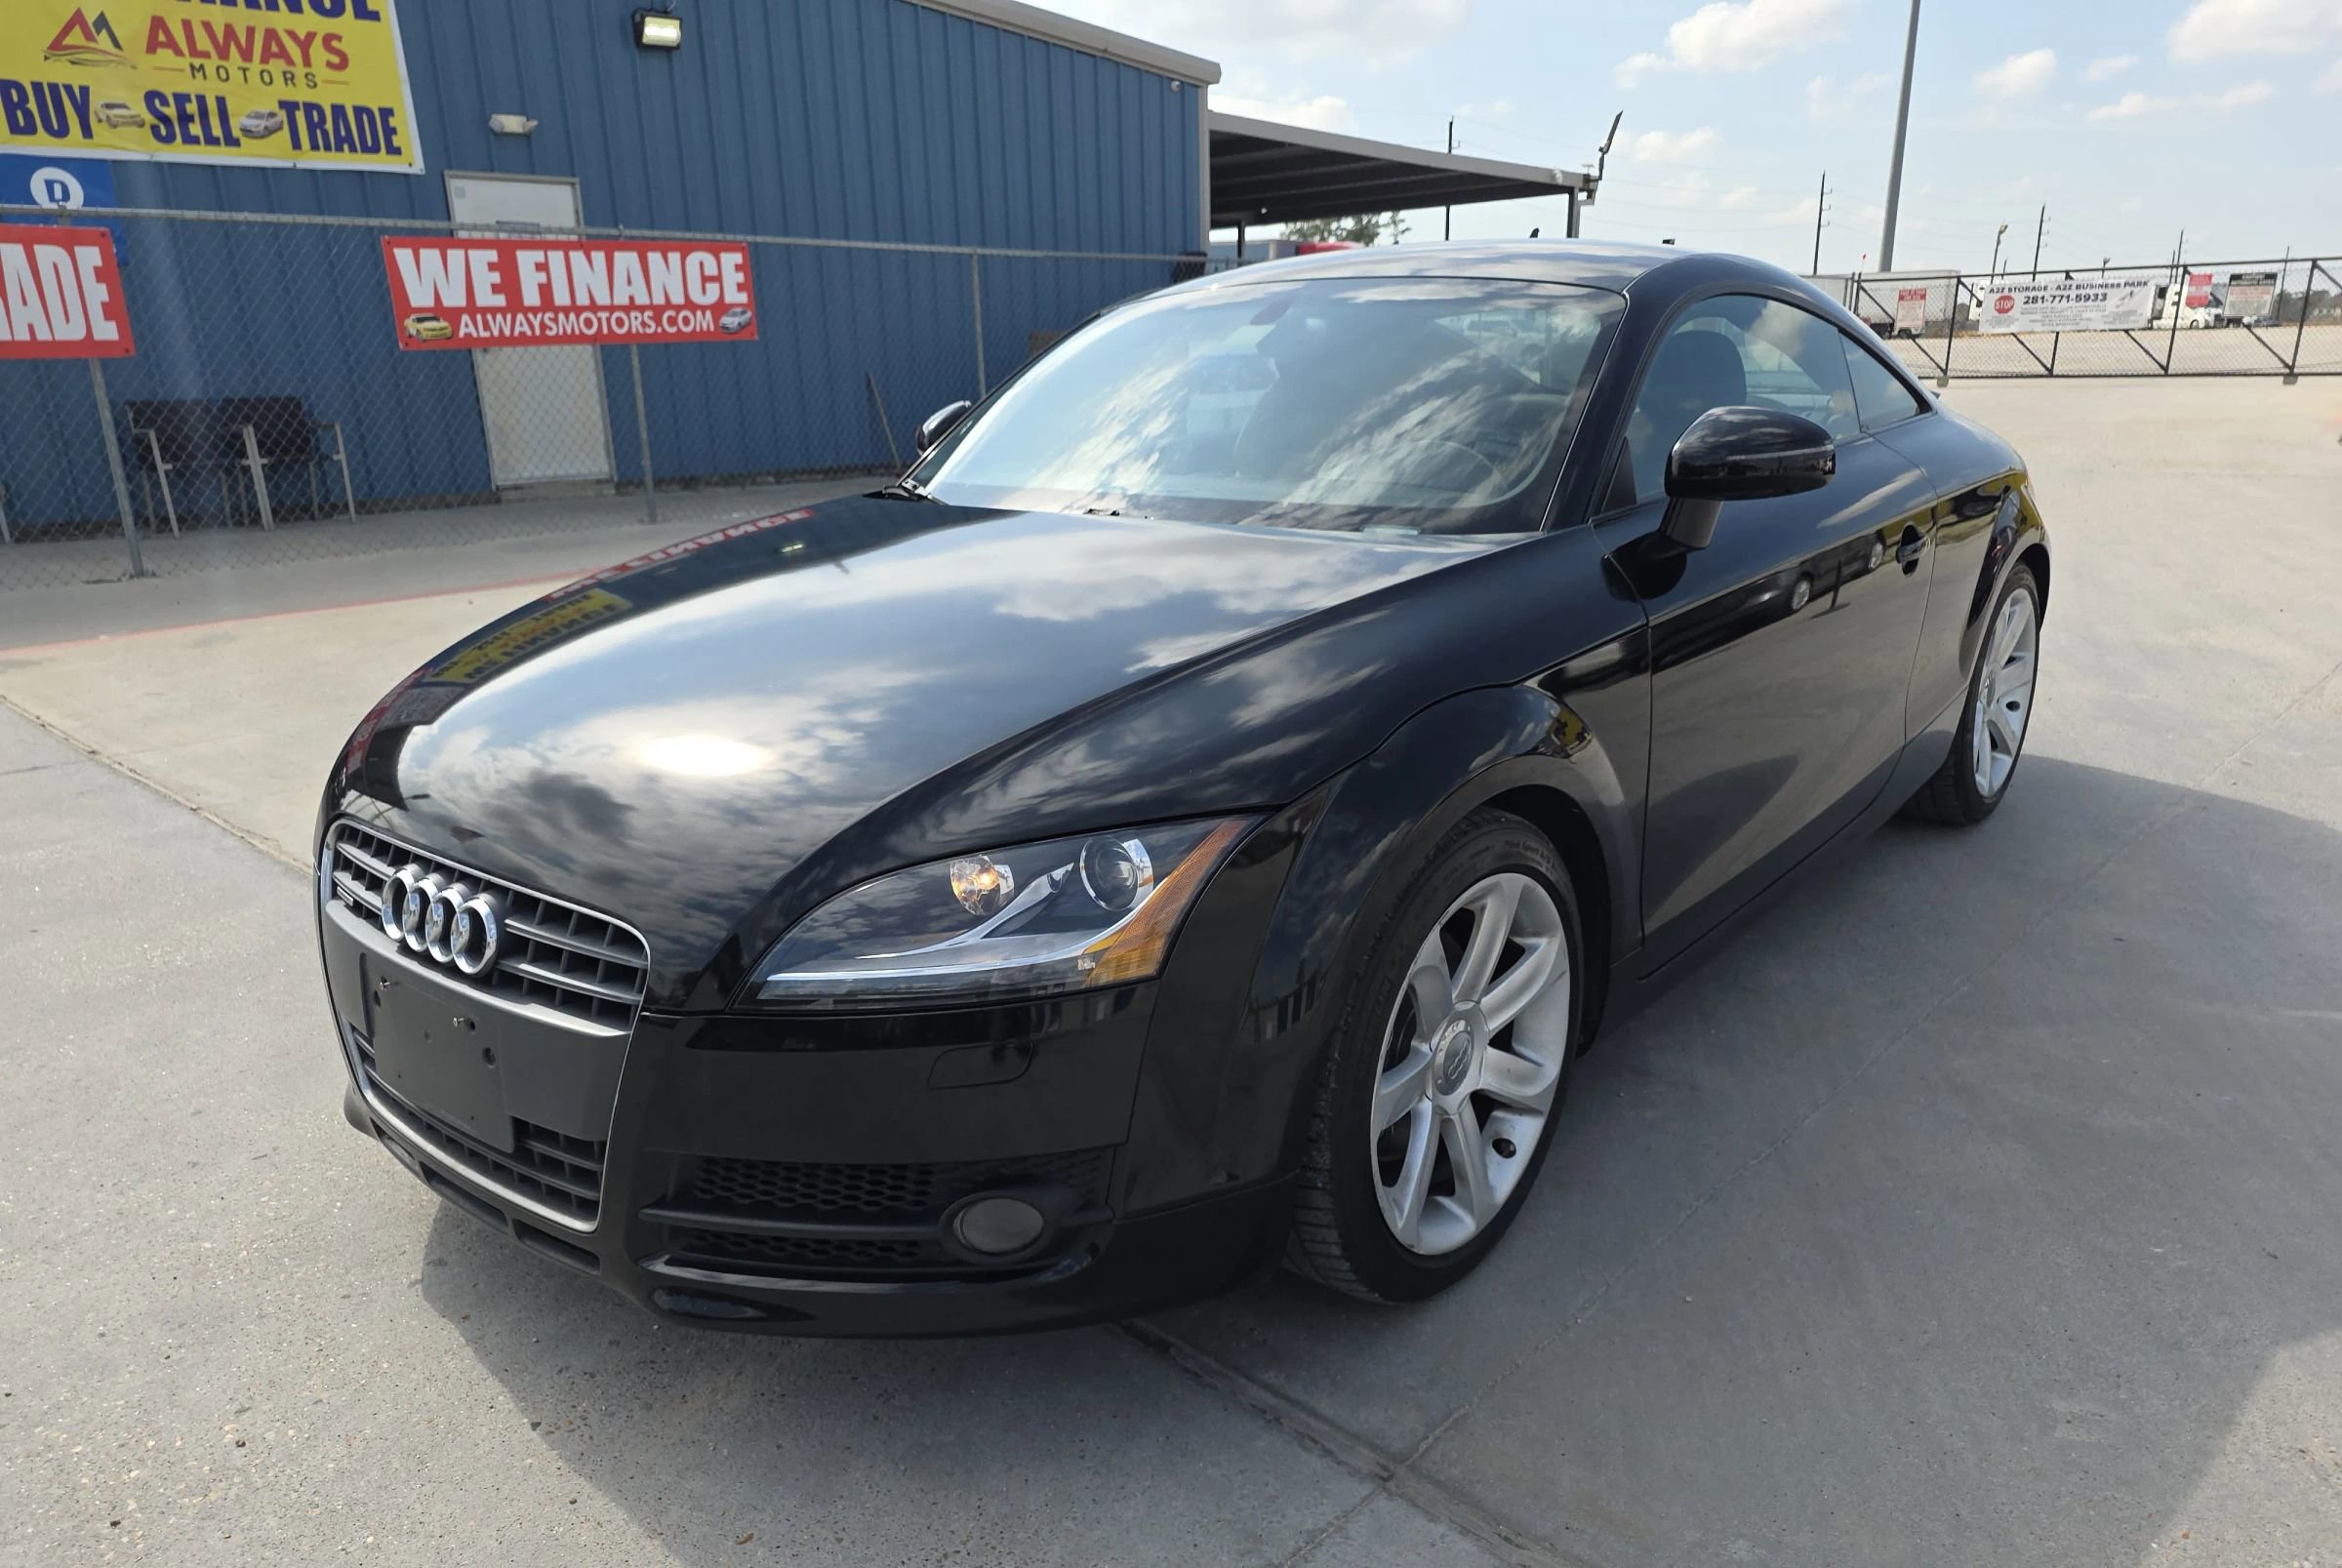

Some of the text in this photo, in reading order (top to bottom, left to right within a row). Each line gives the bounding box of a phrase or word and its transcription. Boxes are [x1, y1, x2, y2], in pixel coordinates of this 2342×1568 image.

[145, 15, 349, 72] ALWAYS
[189, 62, 318, 89] MOTORS
[0, 79, 402, 155] BUY SELL TRADE
[0, 243, 119, 341] ADE
[393, 247, 748, 307] WE FINANCE
[1995, 299, 2014, 309] STOP
[459, 308, 714, 339] ALWAYSMOTORS.COM
